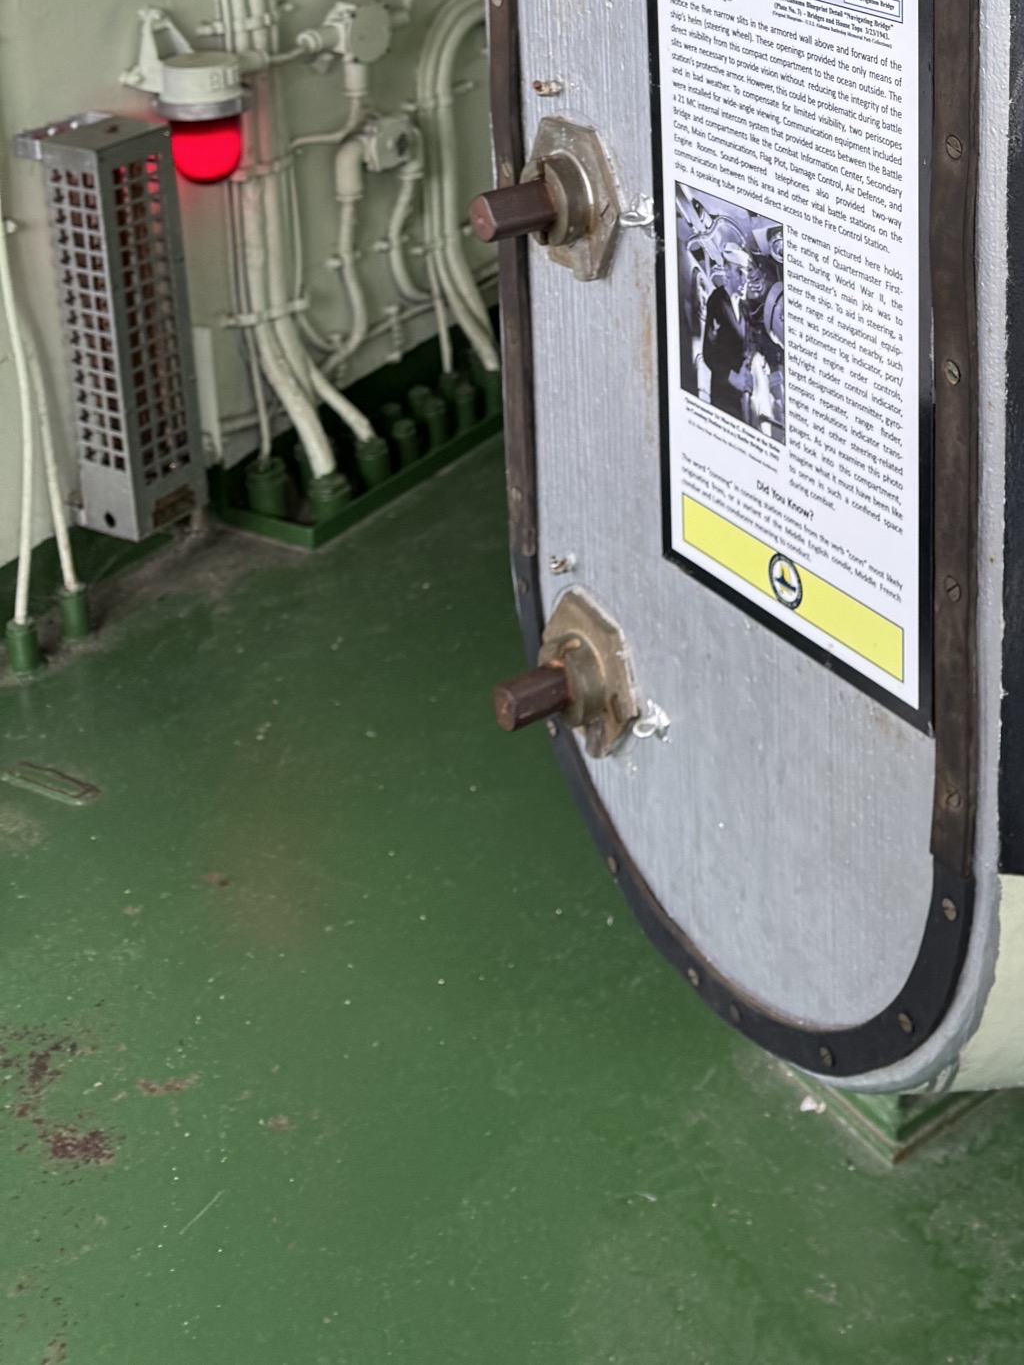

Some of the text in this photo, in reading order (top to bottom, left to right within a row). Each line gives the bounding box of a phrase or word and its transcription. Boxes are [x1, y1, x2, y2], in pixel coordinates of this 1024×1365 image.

[689, 1, 699, 12] the
[701, 3, 712, 15] five
[713, 9, 735, 22] narrow
[736, 14, 748, 26] slits
[757, 21, 768, 32] the
[770, 26, 797, 40] armored
[798, 34, 812, 45] wall
[813, 37, 834, 52] above
[835, 45, 849, 56] and
[850, 47, 878, 64] forward
[889, 59, 902, 71] the
[673, 105, 902, 199] Bridge and compartments like the Combat Information Center, Secondary
[674, 161, 687, 173] ship.
[695, 170, 721, 188] speaking
[721, 179, 735, 191] tube
[736, 186, 763, 203] provided
[763, 195, 781, 210] direct
[782, 204, 802, 218] access
[811, 215, 823, 227] the
[824, 219, 836, 232] Fire
[837, 225, 862, 242] Control
[863, 235, 890, 254] Station.
[785, 224, 903, 281] The crewman pictured here holds
[786, 239, 797, 251] the
[800, 246, 819, 262] rating
[832, 258, 882, 287] Quartermaster
[885, 280, 903, 295] First-
[786, 253, 804, 268] Class.
[808, 262, 830, 282] During
[834, 273, 855, 290] World
[859, 284, 874, 298] War
[890, 299, 903, 311] the
[787, 497, 814, 521] Know?
